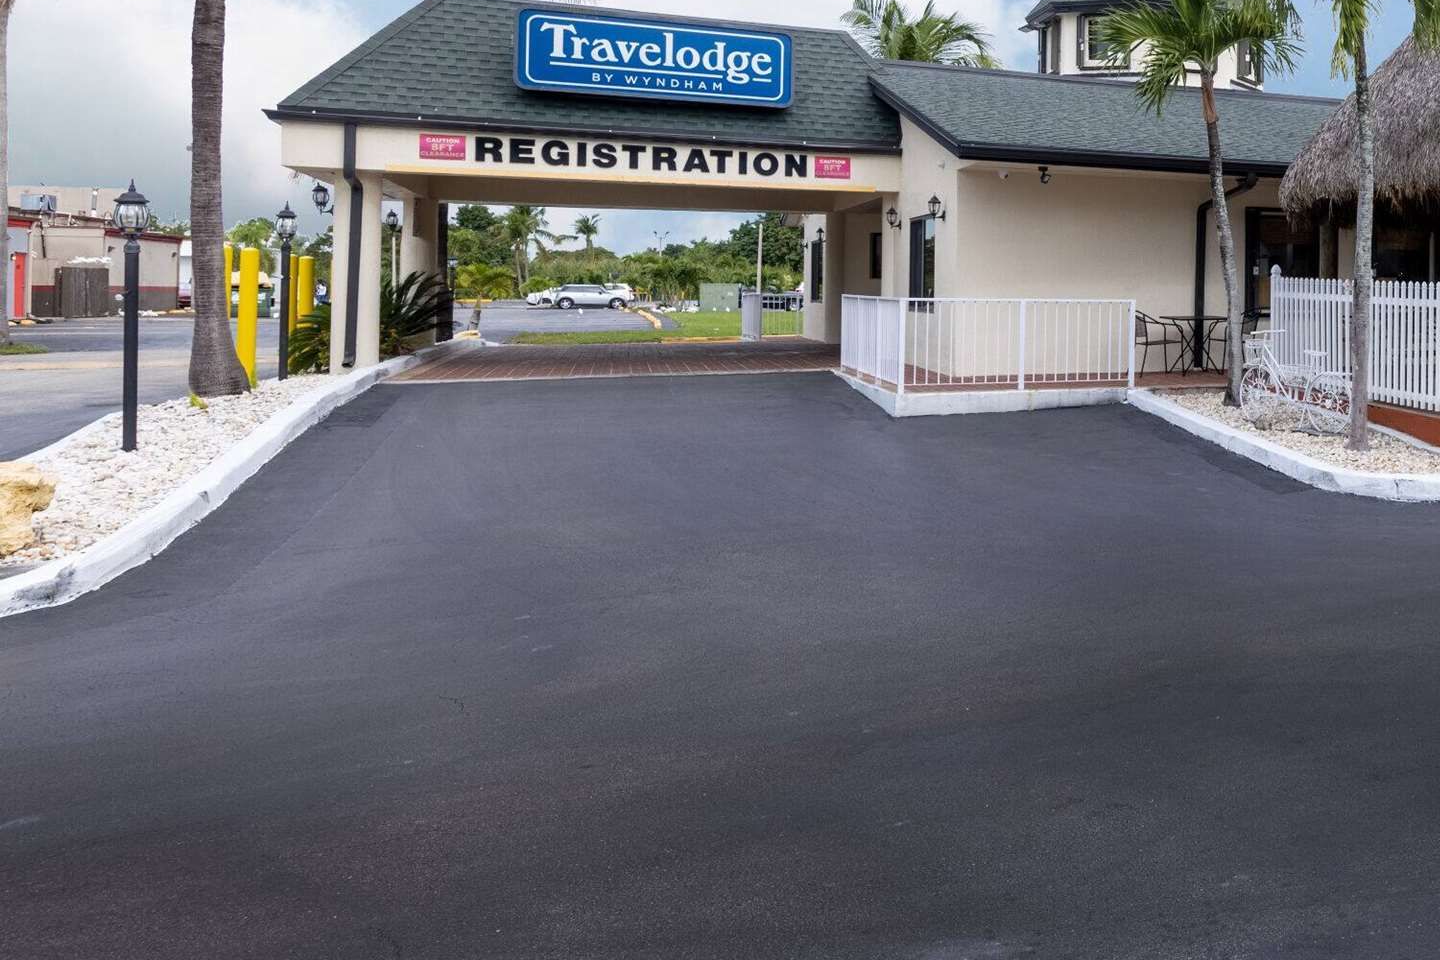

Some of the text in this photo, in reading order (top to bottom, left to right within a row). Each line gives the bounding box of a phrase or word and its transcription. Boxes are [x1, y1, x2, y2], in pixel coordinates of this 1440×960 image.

[540, 22, 772, 84] Travelodge
[592, 72, 723, 91] BY WYNDHAM
[475, 136, 808, 178] REGISTRATION
